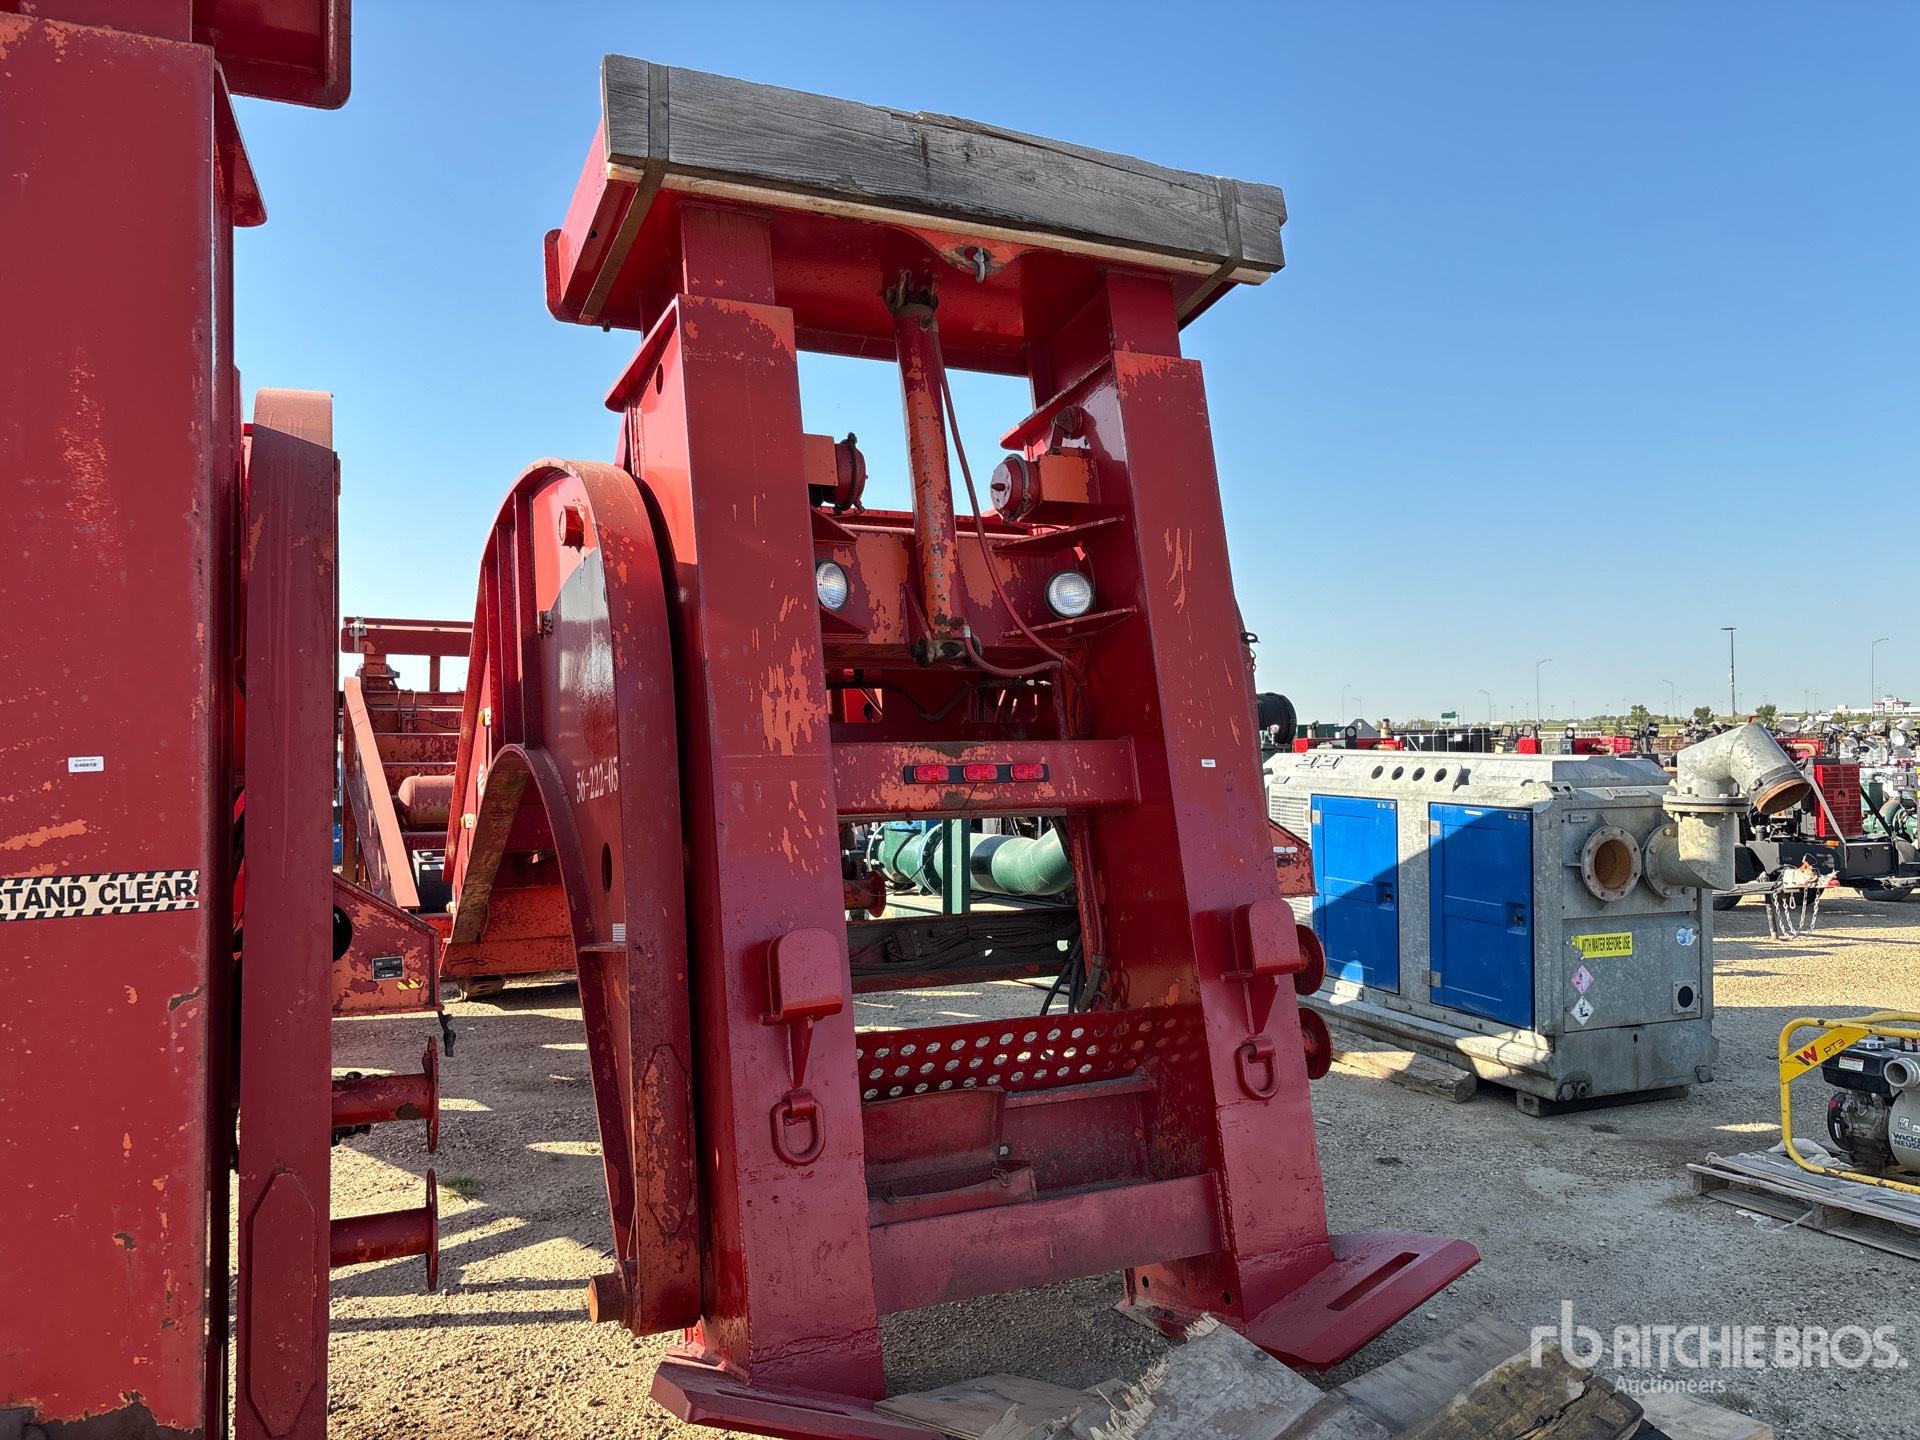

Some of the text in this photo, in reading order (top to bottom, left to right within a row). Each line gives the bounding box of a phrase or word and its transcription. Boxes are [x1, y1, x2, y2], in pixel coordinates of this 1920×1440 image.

[576, 756, 619, 804] 56-222-05
[0, 878, 194, 911] TAND CLEAR
[1592, 938, 1605, 952] WATER
[1606, 936, 1621, 951] BEFORE
[1622, 935, 1630, 949] USE
[1823, 1038, 1846, 1056] PT3
